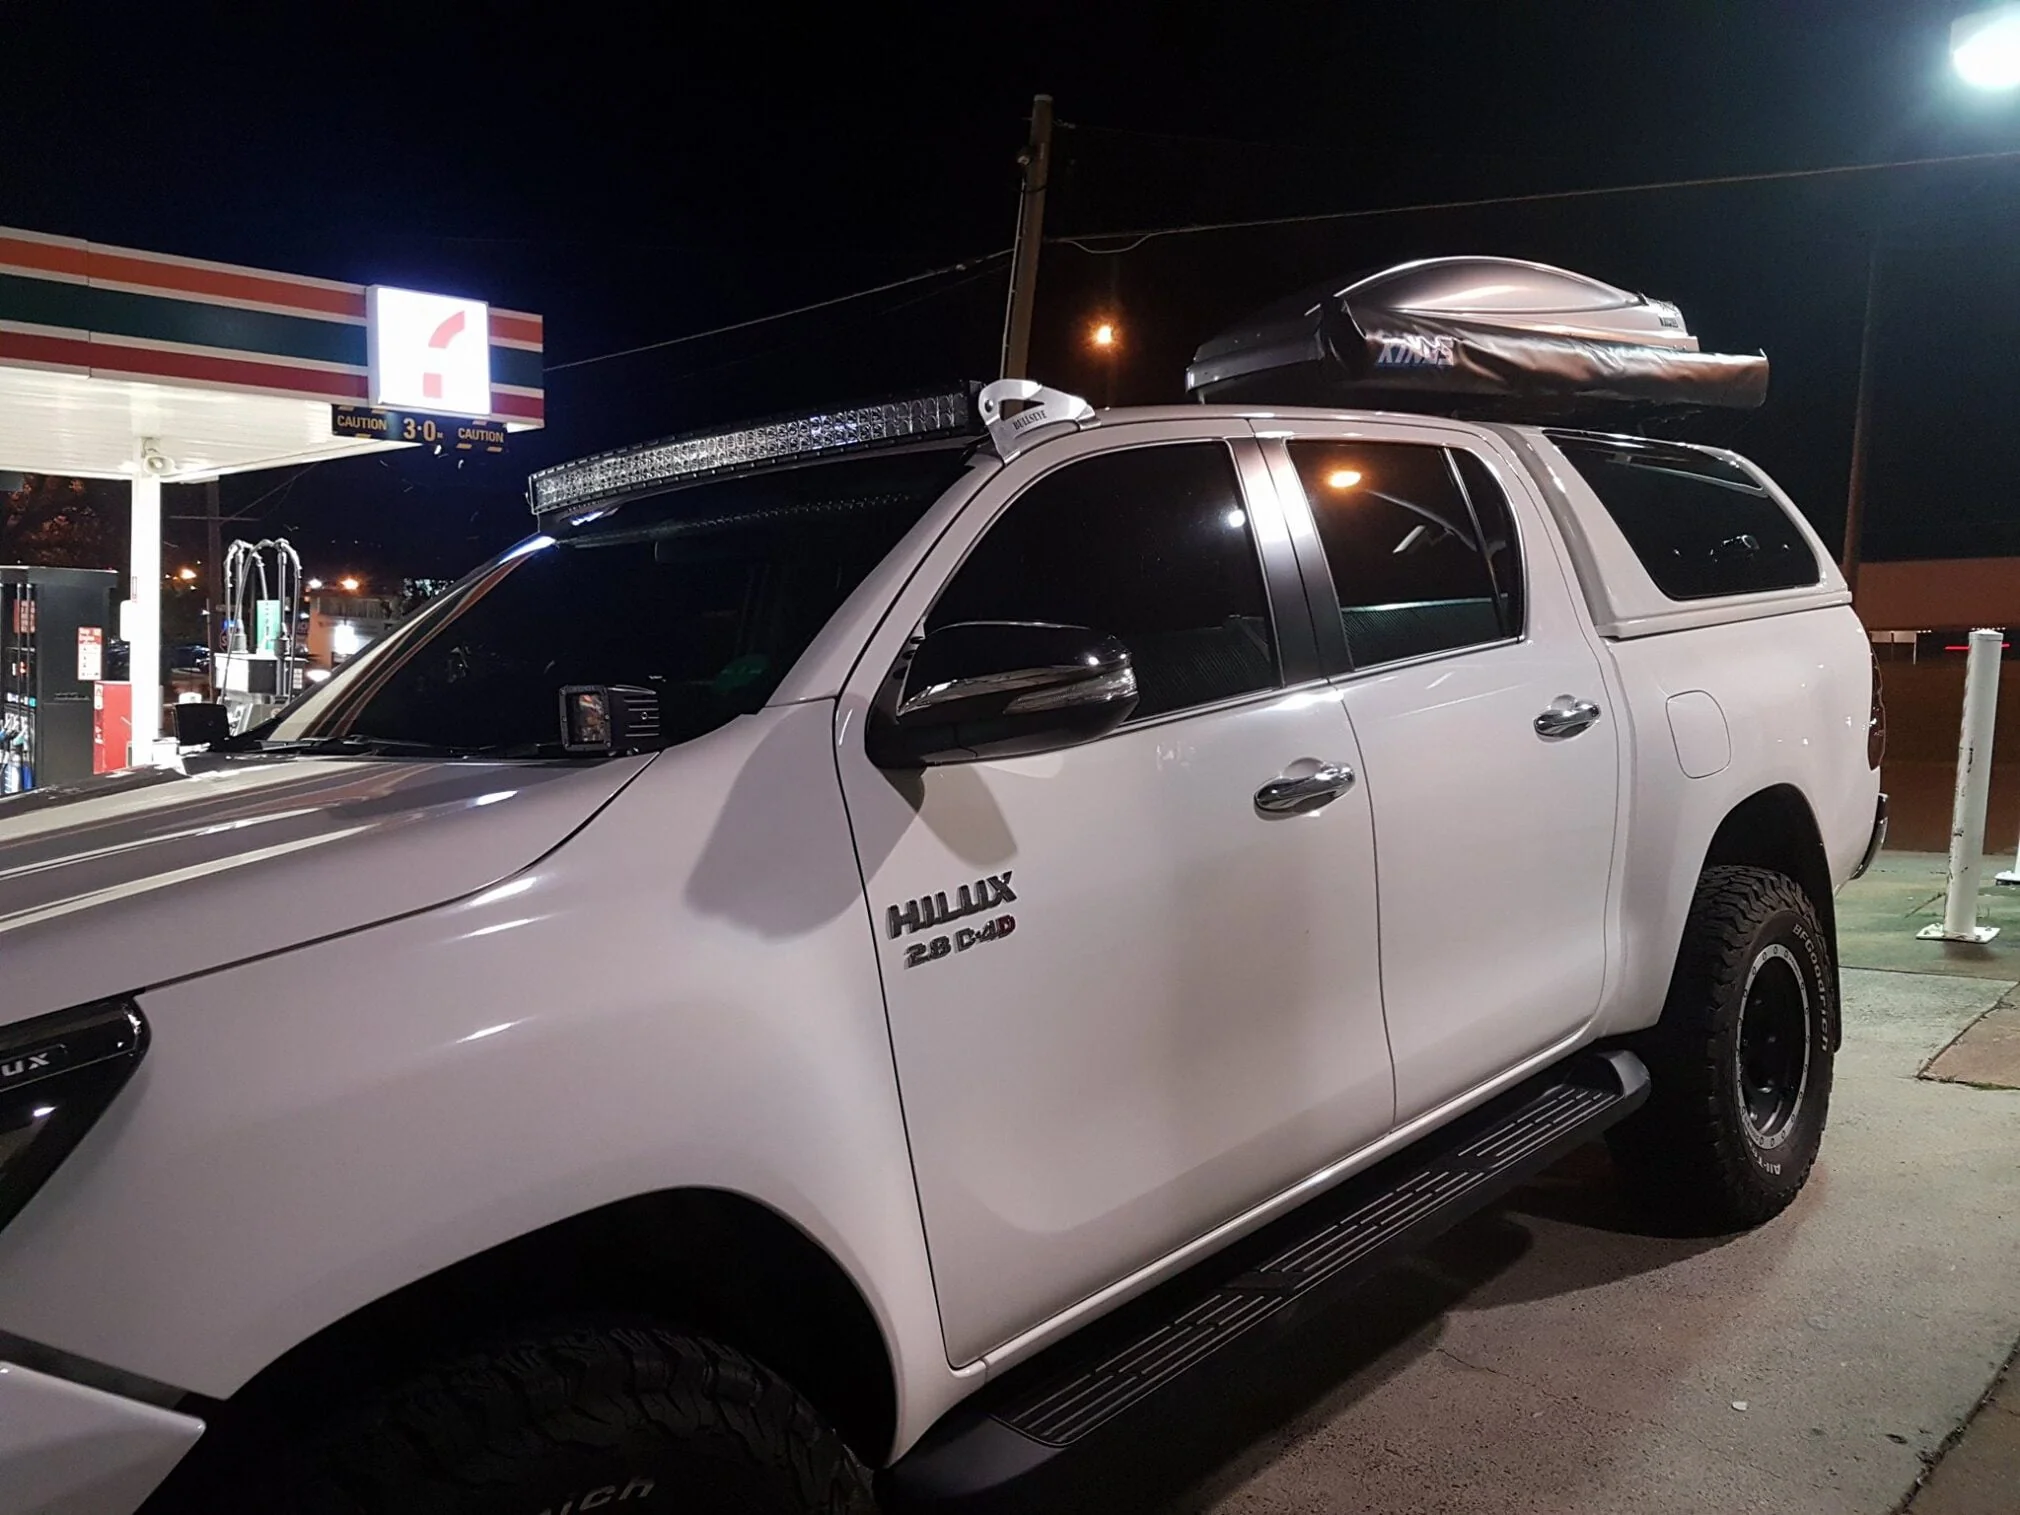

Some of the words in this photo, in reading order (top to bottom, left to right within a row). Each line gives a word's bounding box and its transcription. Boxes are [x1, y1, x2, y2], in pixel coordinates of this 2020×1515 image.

[336, 415, 387, 431] CAUTION
[1012, 409, 1048, 431] BULLSEYE
[458, 427, 504, 443] CAUTION
[885, 870, 1018, 941] HILUX
